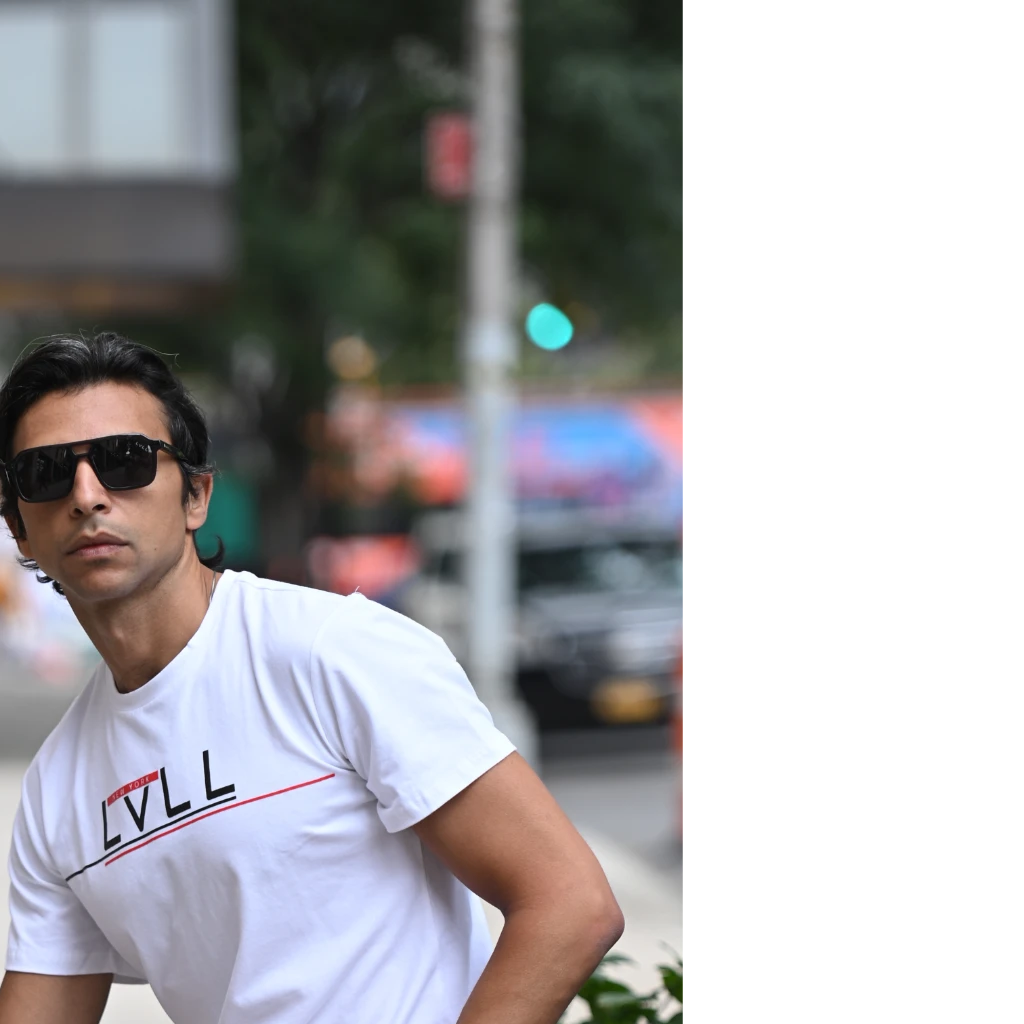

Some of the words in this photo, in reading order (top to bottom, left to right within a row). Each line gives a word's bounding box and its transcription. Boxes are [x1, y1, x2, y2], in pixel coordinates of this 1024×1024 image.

[102, 750, 235, 850] LVLL
[112, 788, 125, 800] NEW
[128, 775, 150, 790] YORK
